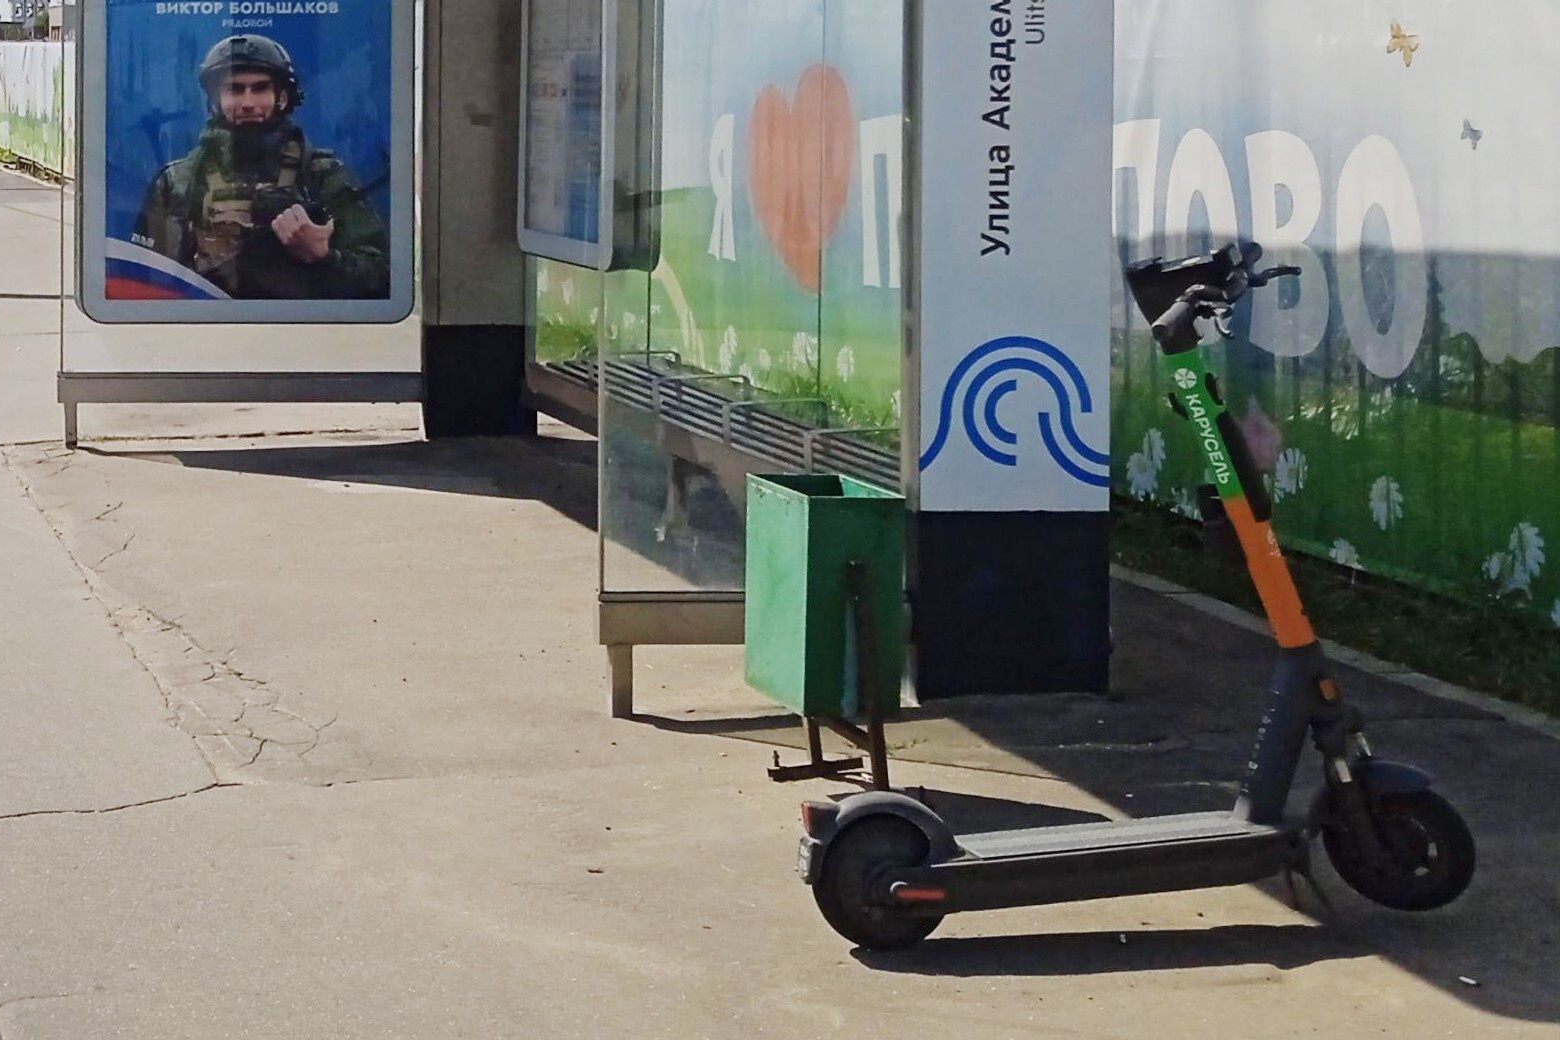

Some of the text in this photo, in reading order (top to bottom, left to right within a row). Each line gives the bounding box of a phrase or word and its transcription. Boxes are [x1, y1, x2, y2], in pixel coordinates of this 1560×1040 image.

[155, 1, 339, 15] ВИКТОР БОЛЬШАКОВ
[707, 113, 737, 262] Я
[980, 144, 1014, 256] Улица
[1185, 393, 1230, 485] КАРУСЕЛЬ
